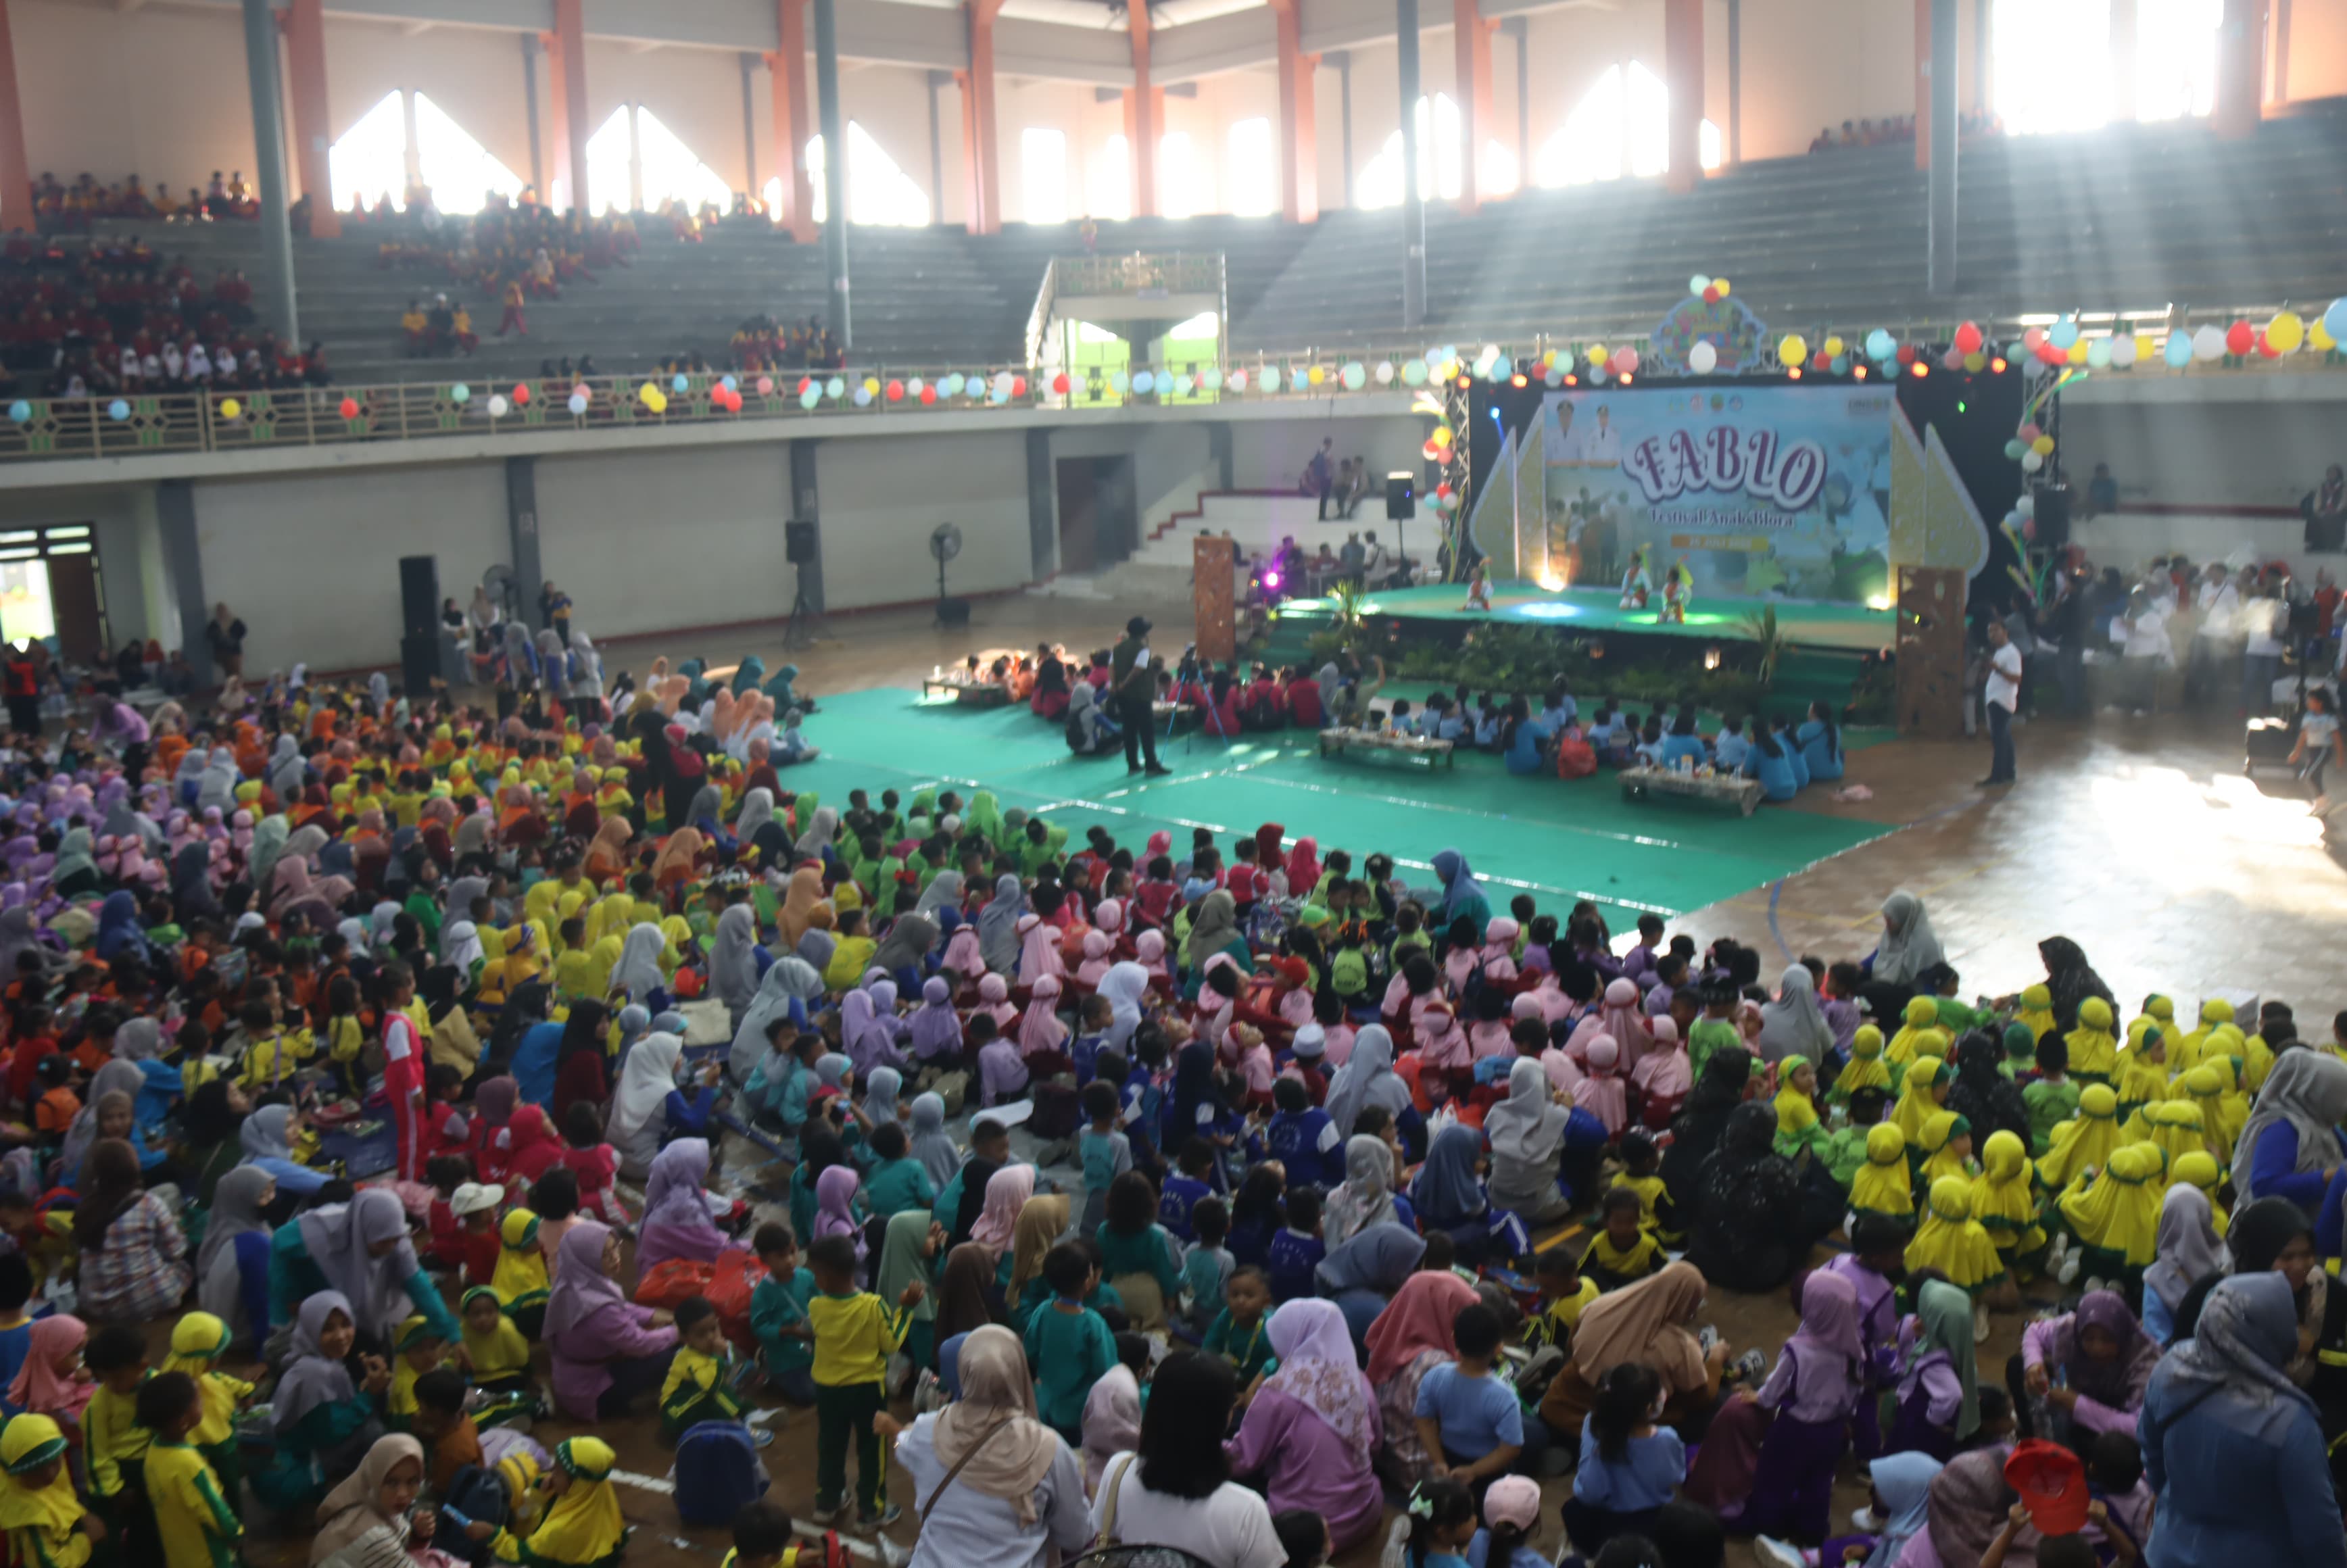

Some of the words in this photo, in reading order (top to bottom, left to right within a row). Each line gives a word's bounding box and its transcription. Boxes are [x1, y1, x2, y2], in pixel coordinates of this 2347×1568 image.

[1633, 424, 1818, 501] FABLO
[1650, 508, 1704, 525] Festival
[1708, 509, 1748, 526] Anak
[1753, 510, 1795, 527] Blora
